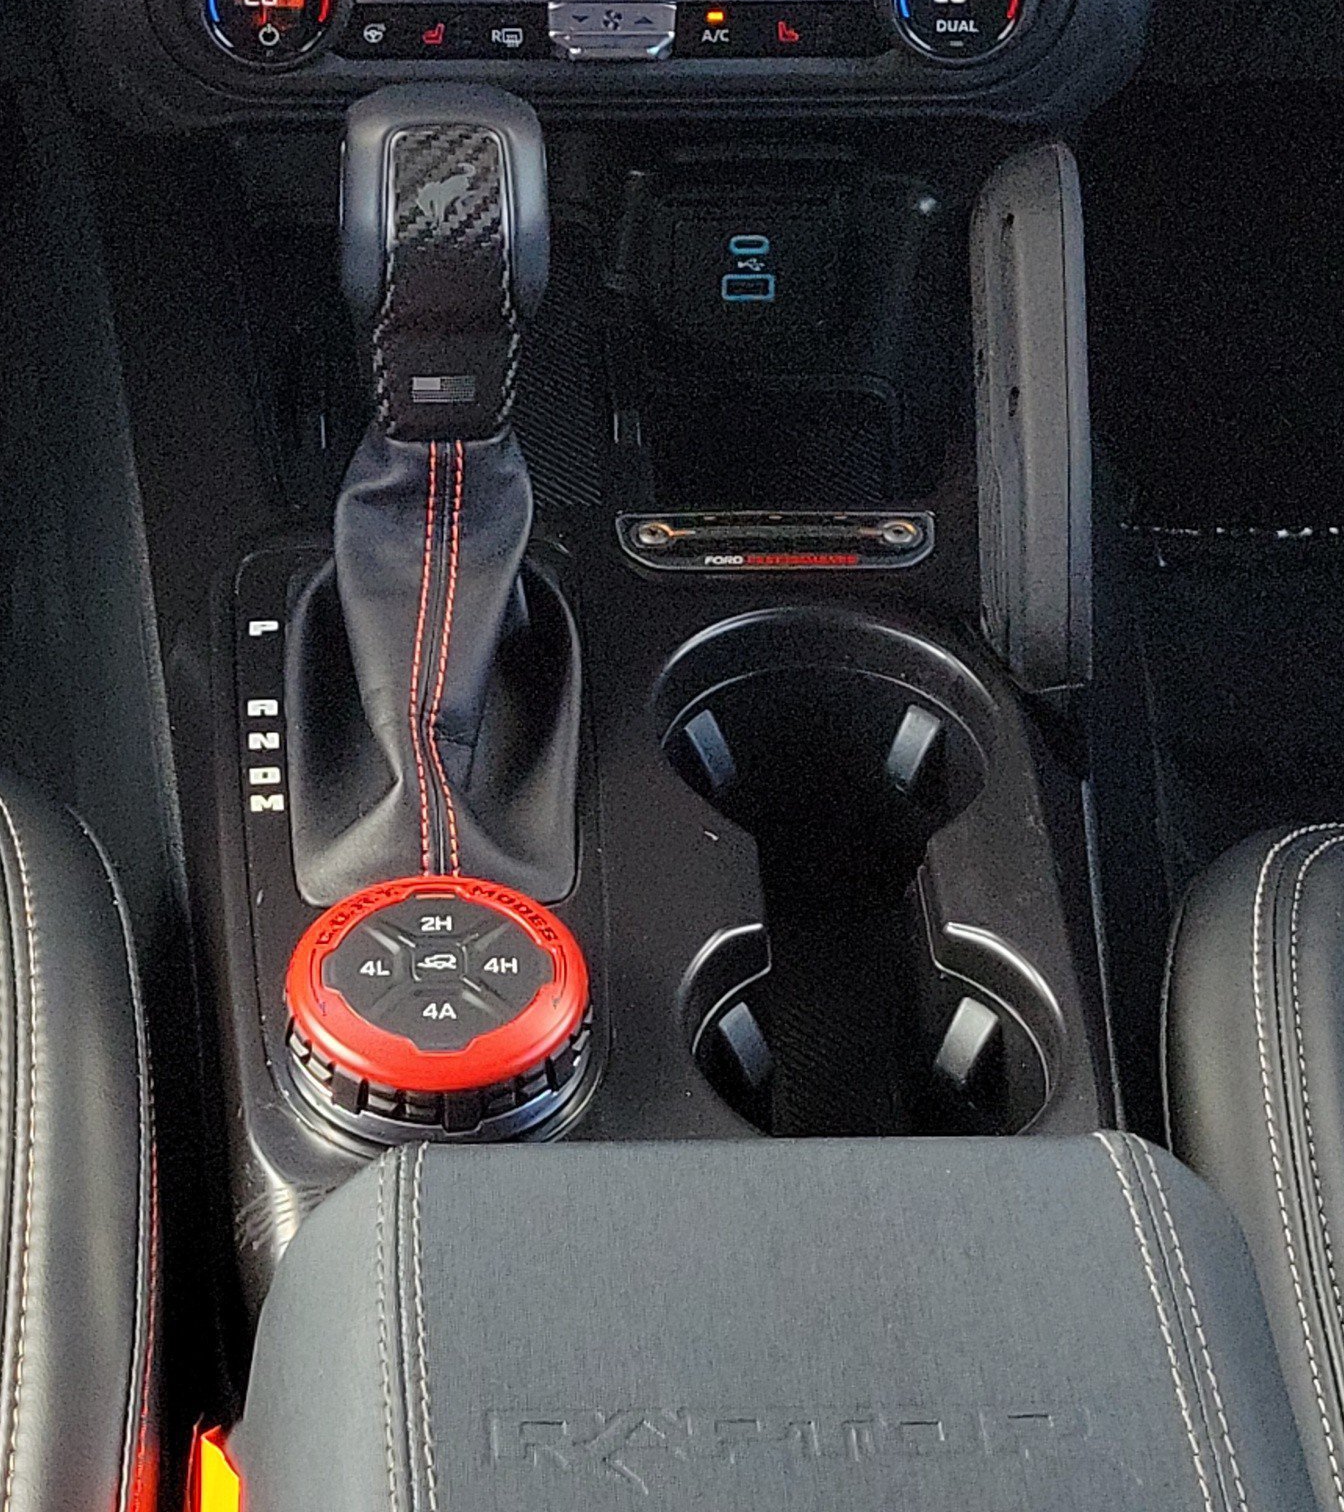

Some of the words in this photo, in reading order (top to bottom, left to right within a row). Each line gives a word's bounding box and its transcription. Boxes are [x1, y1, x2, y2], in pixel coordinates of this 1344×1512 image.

[935, 19, 979, 34] DUAL
[701, 29, 730, 44] A/C
[704, 555, 744, 565] FORD
[248, 620, 279, 636] P
[248, 732, 280, 750] N
[250, 794, 285, 812] M
[471, 885, 560, 943] MODES
[420, 916, 453, 932] 2H
[359, 960, 391, 977] 4L
[483, 957, 519, 974] 4H
[422, 1002, 457, 1020] 4A
